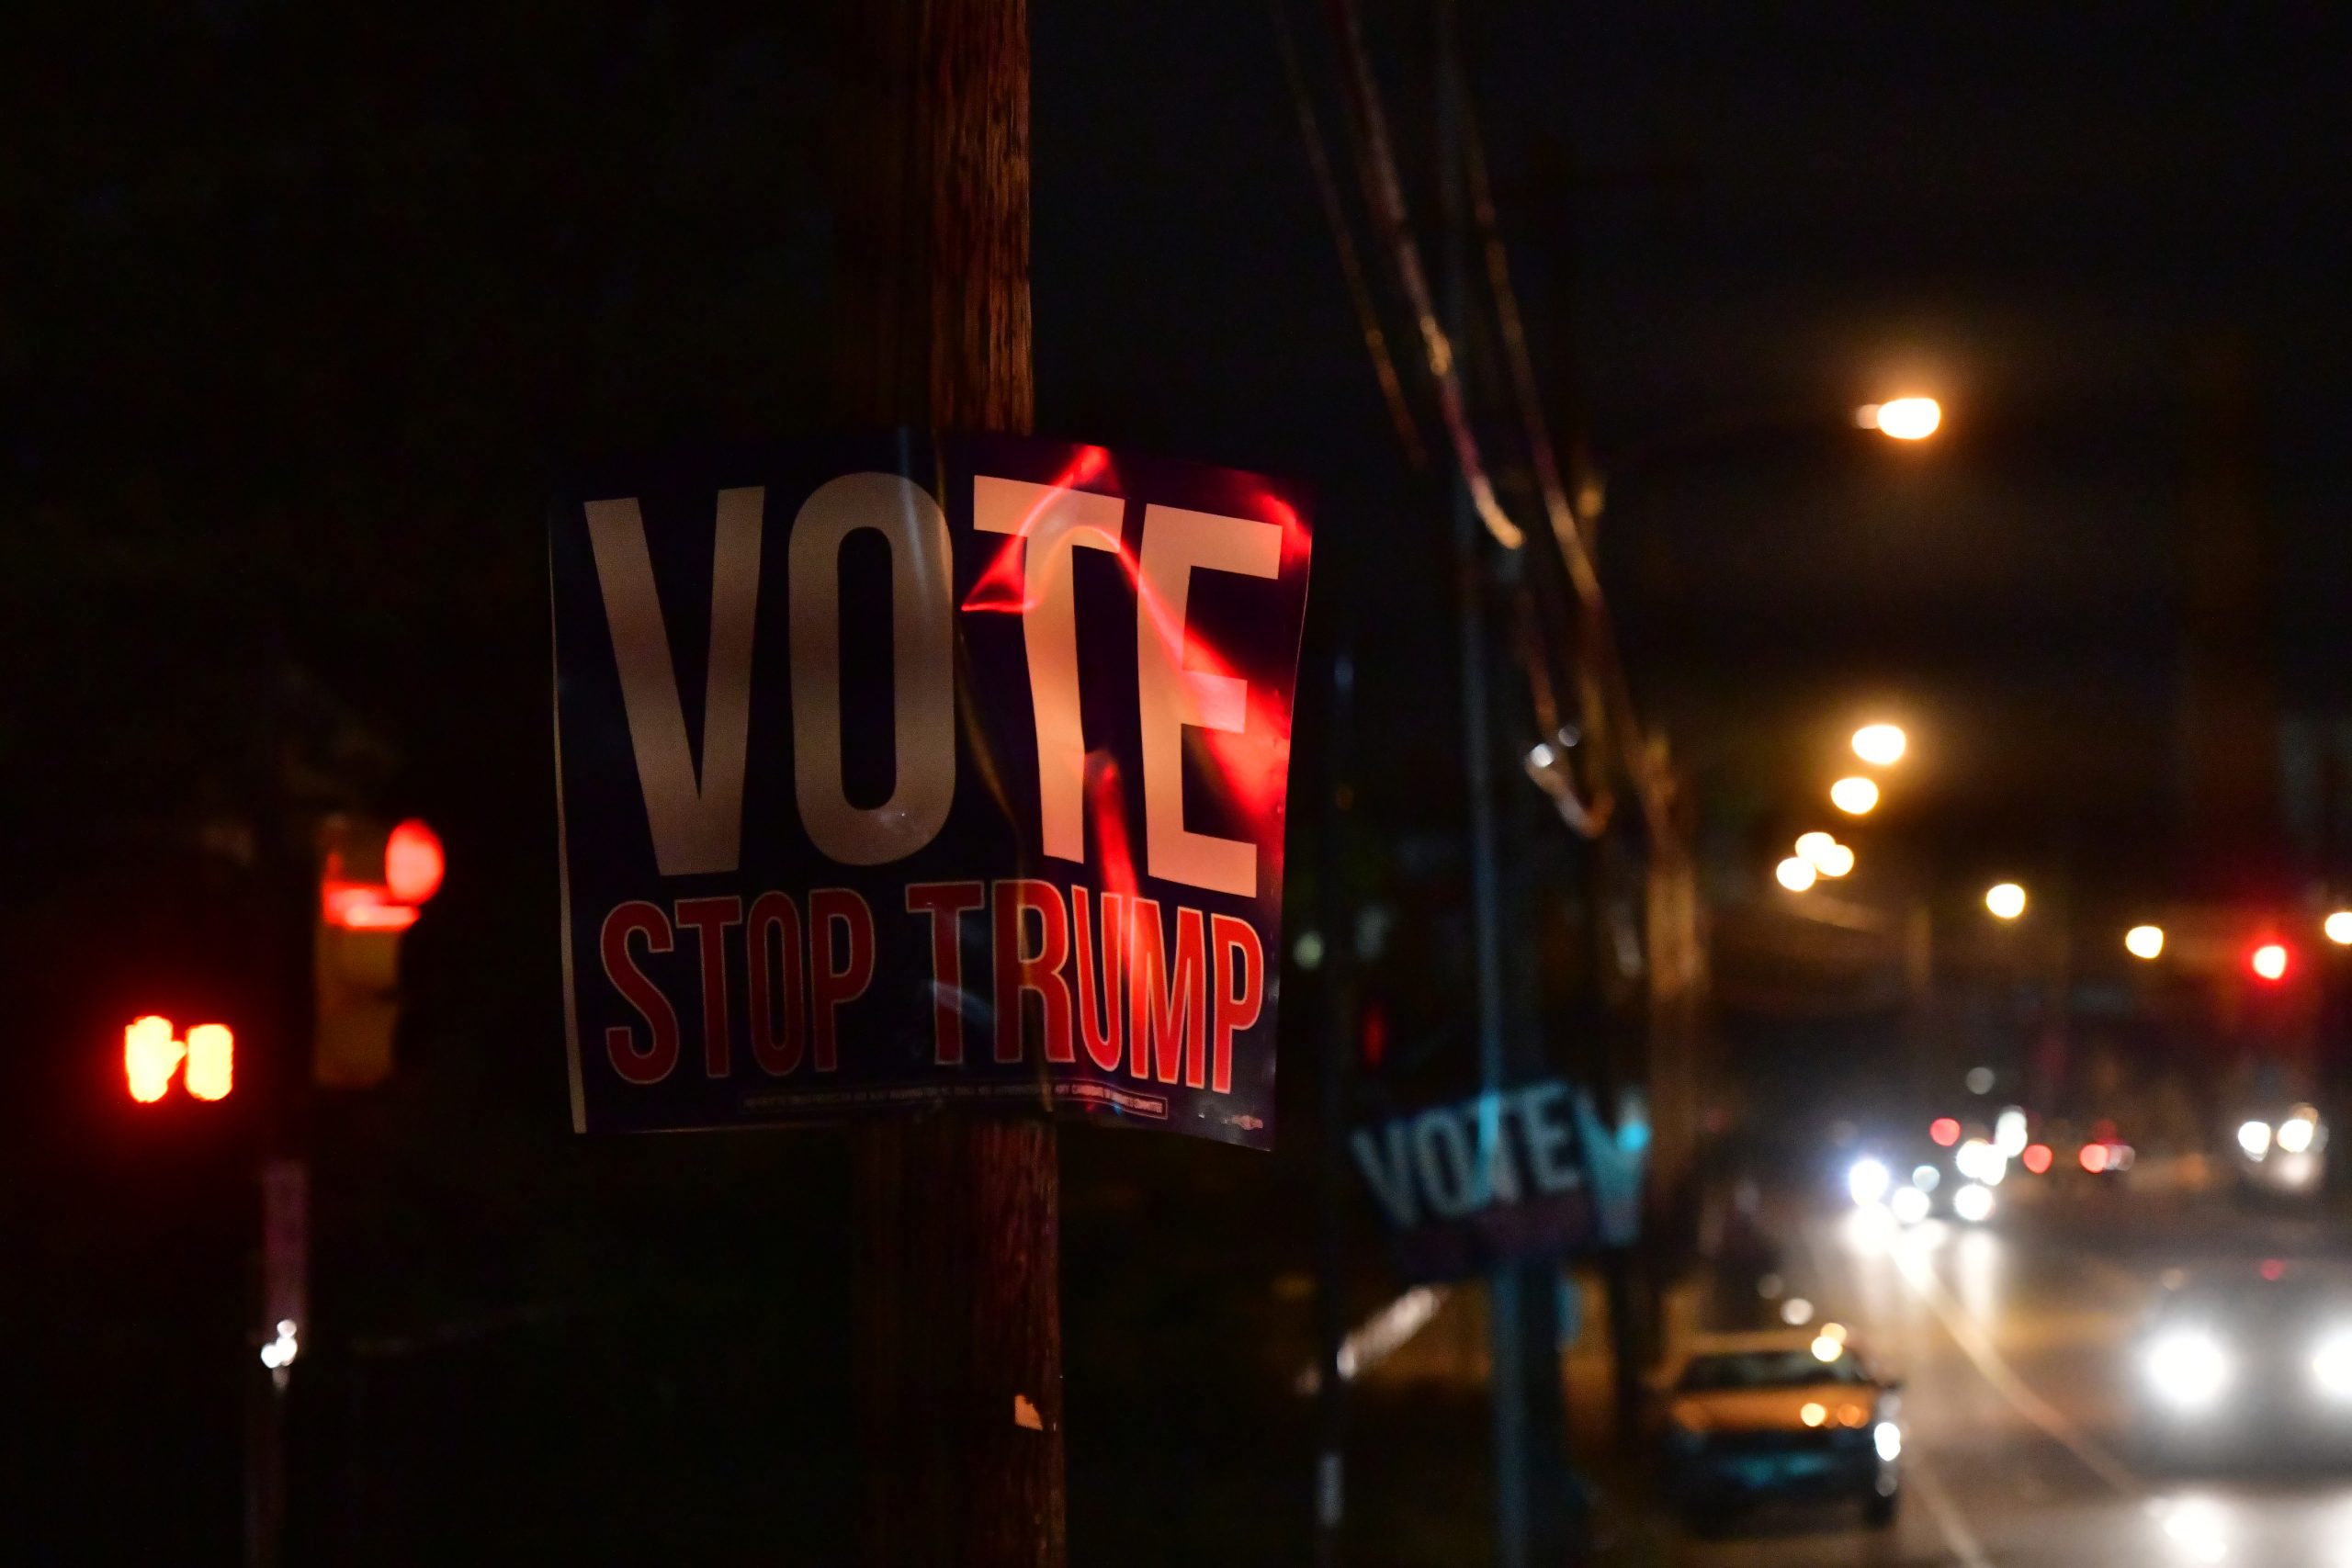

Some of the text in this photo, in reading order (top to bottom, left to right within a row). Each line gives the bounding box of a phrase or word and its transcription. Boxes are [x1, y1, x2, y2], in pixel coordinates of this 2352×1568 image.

[583, 470, 1283, 898] VOTE
[599, 877, 1265, 1094] STOP TRUMP
[1349, 1079, 1583, 1230] VOTE
